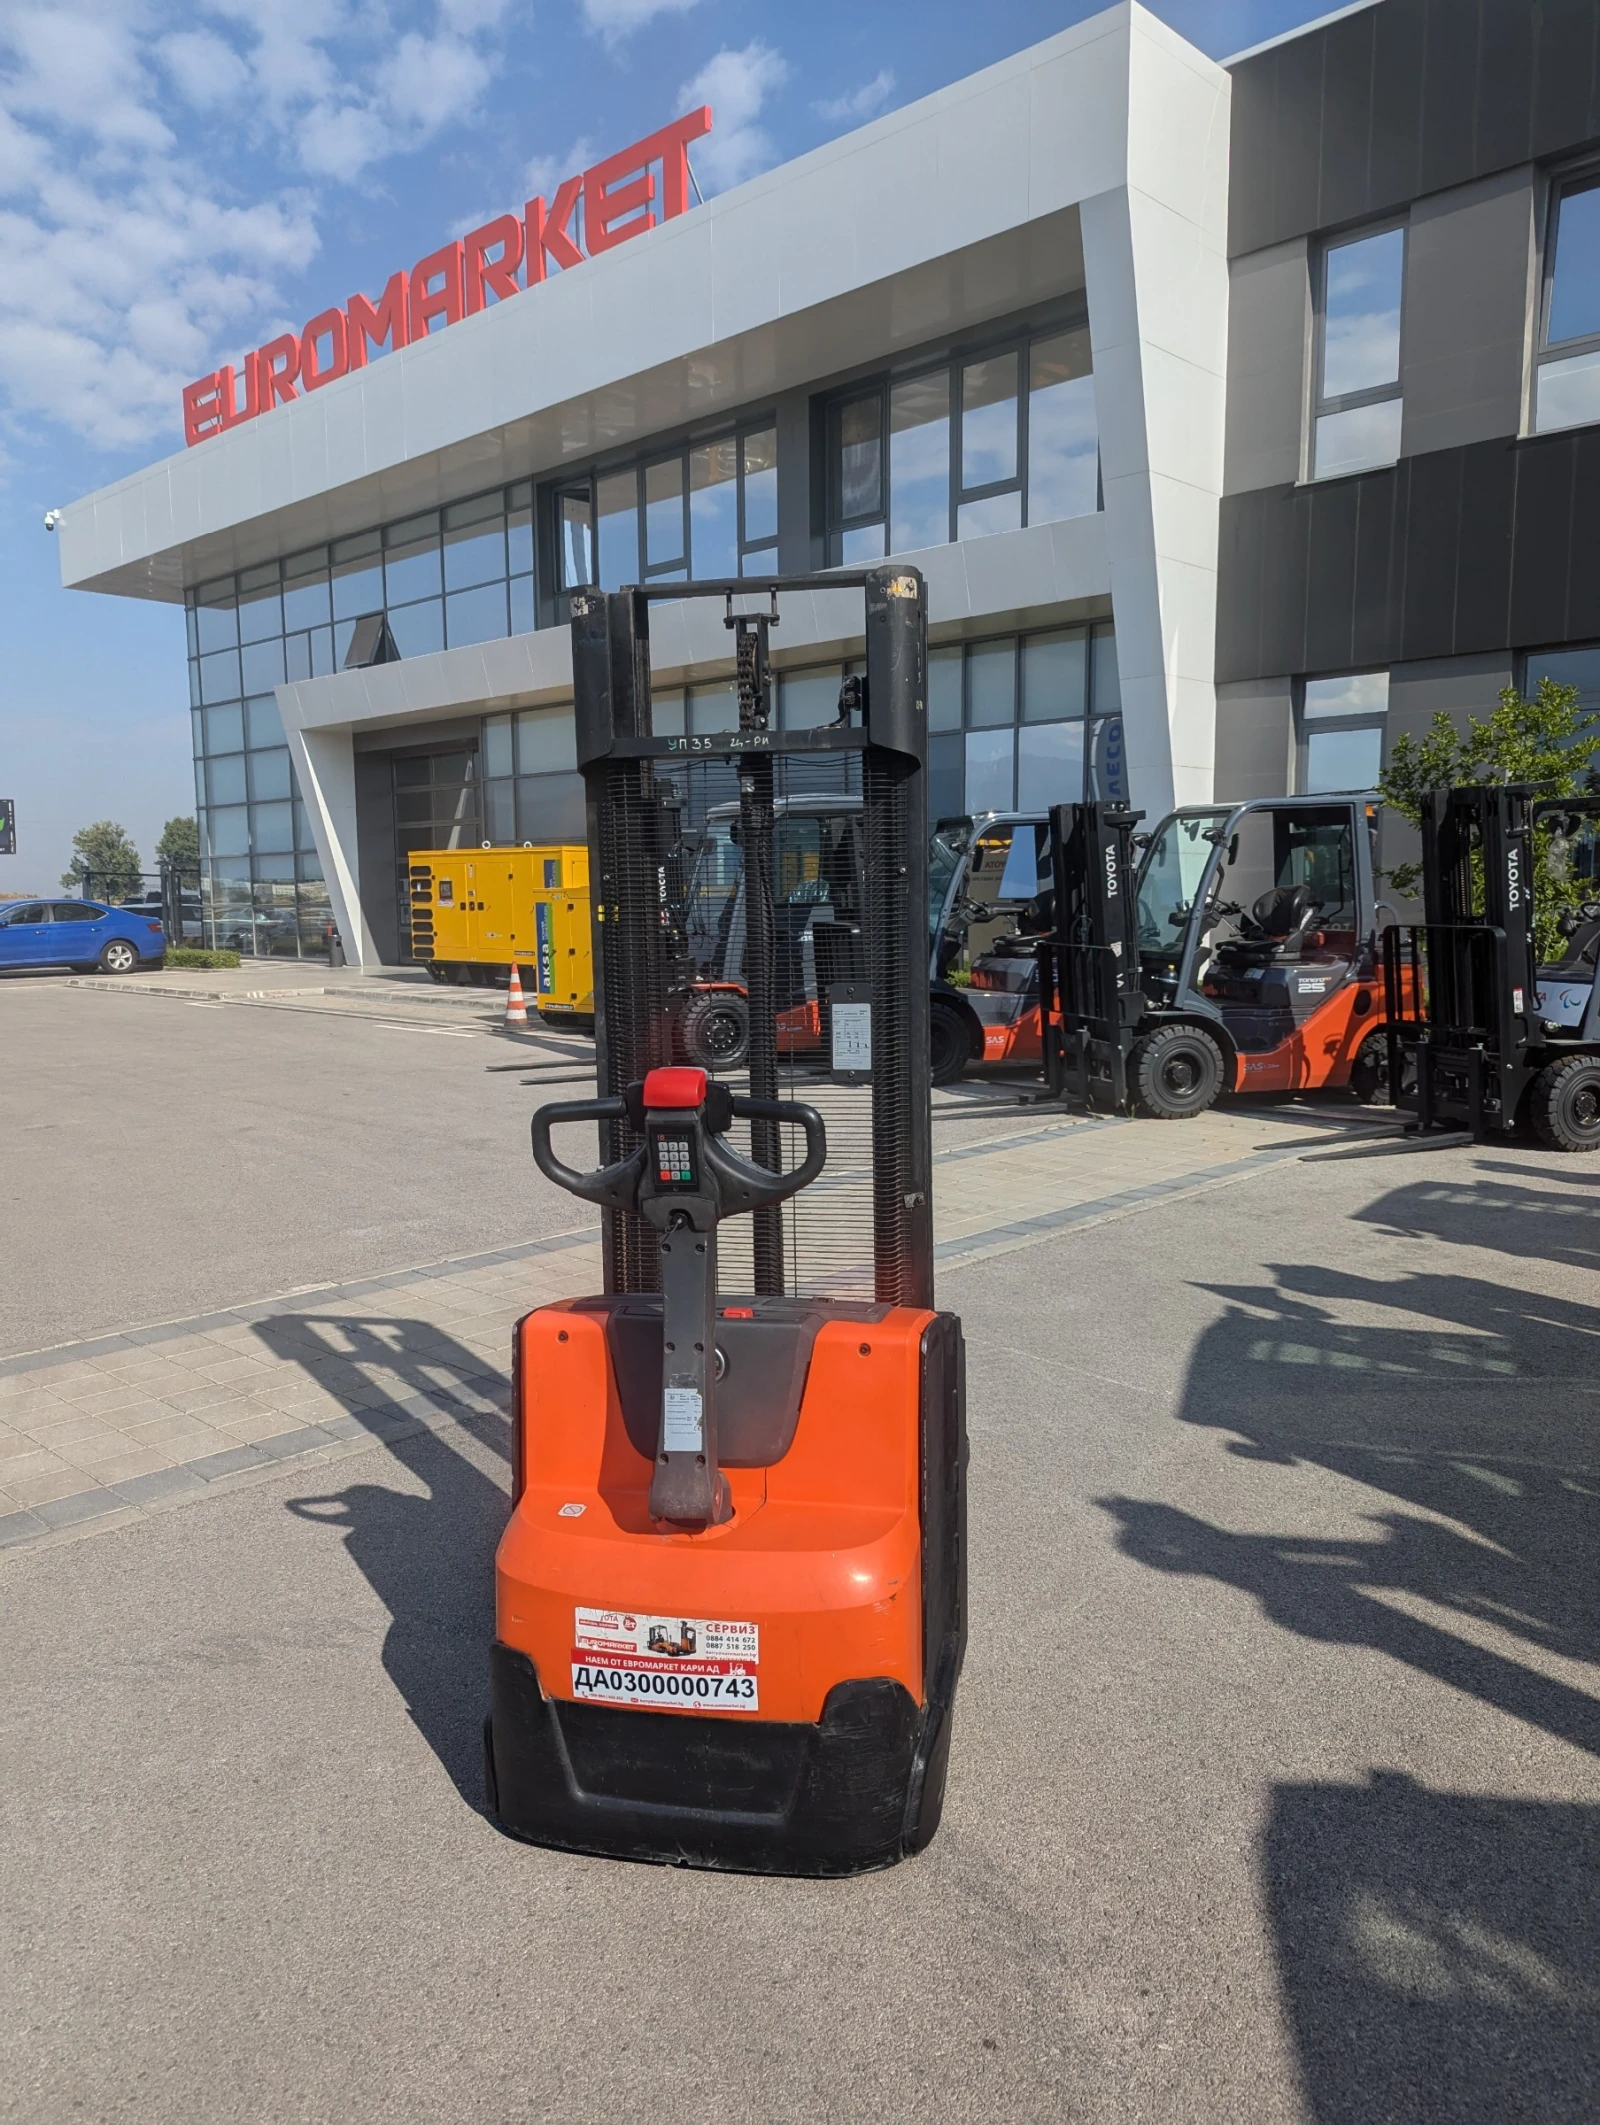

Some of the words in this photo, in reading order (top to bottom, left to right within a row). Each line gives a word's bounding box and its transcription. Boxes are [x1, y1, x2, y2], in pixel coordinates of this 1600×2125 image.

[183, 106, 711, 447] EUROMARKET
[1106, 844, 1118, 898] TOYOTA
[1508, 849, 1519, 911] TOYOTA
[543, 944, 551, 987] aksa
[1298, 983, 1326, 993] 25
[705, 1623, 756, 1635] СЕРВИЗ
[726, 1635, 740, 1643] 414
[705, 1642, 723, 1650] 0887
[585, 1655, 609, 1665] НАЕМ
[610, 1657, 621, 1666] ОТ
[623, 1660, 679, 1671] ЕВРОМАРКЕТ
[680, 1664, 705, 1672] КАРИ
[706, 1665, 720, 1674] АД
[575, 1667, 755, 1698] ДА0300000743
